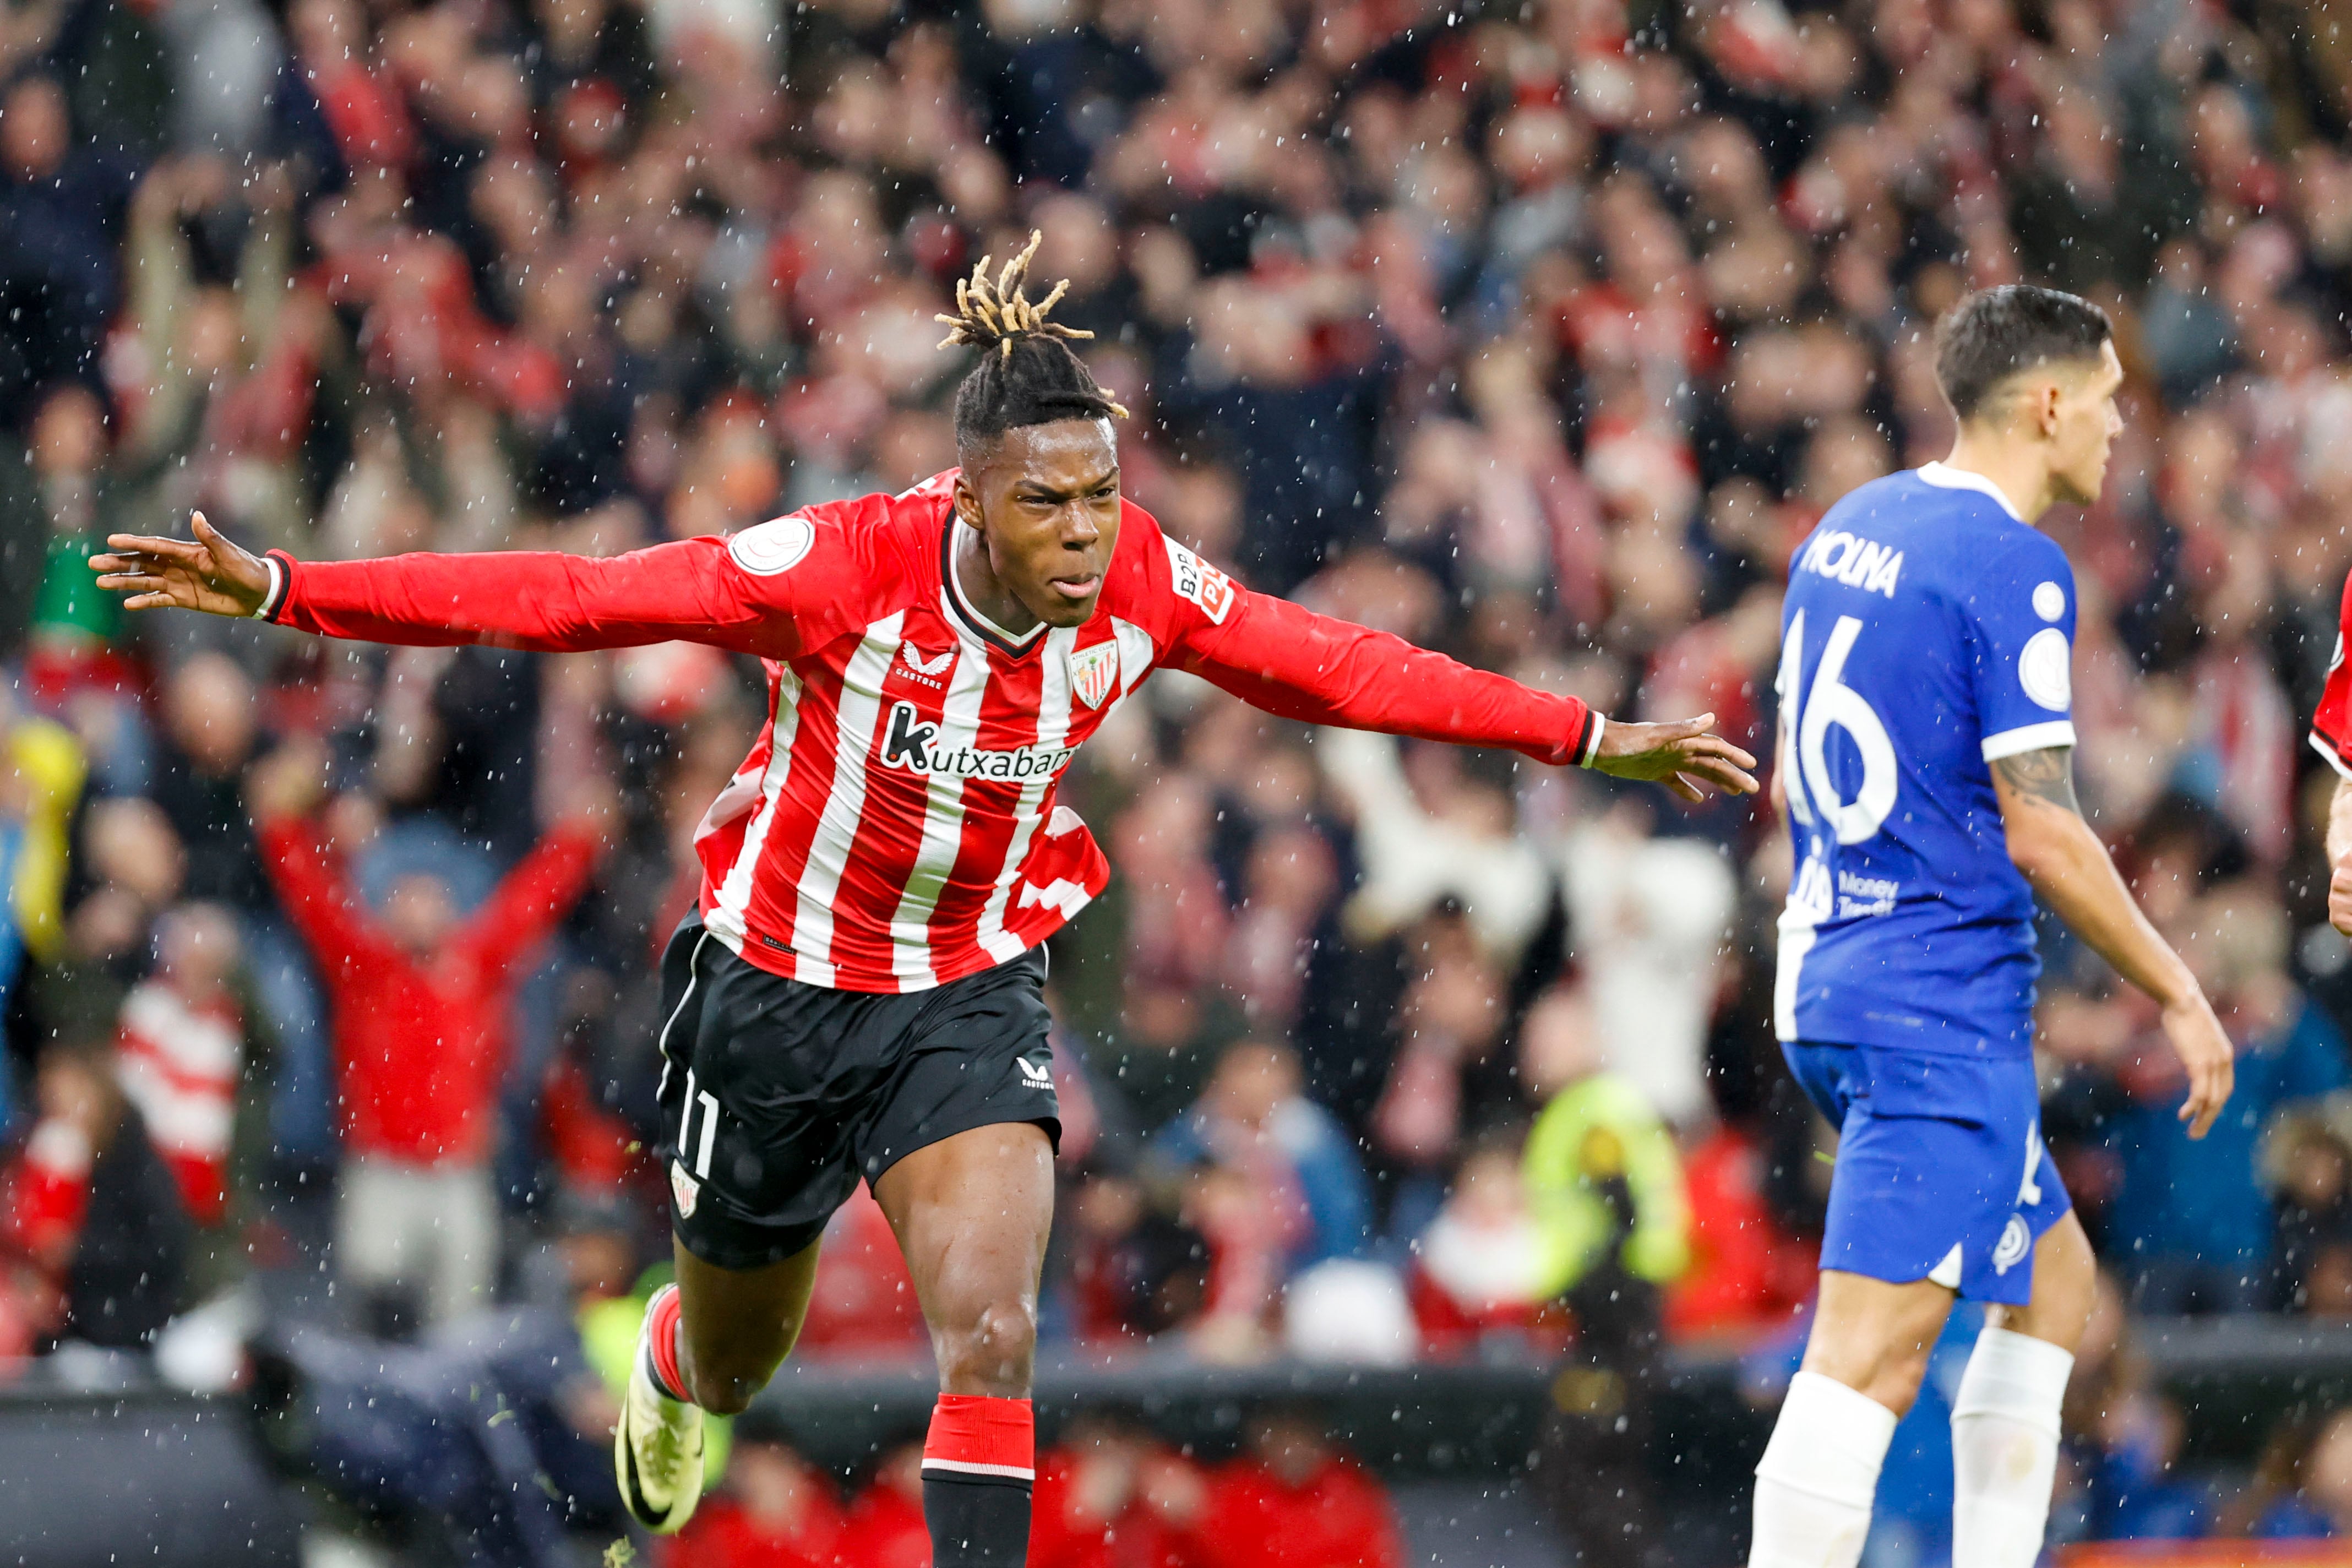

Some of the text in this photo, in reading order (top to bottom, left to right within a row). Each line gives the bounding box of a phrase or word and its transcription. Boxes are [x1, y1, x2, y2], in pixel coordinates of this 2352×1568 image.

[1072, 643, 1114, 661] ATHLETIC CLUB
[896, 667, 943, 690] CASTORE
[1085, 688, 1106, 708] BILBAO
[886, 706, 1085, 777] Kutxaban
[1782, 607, 1898, 845] 16
[678, 1065, 720, 1180] 11
